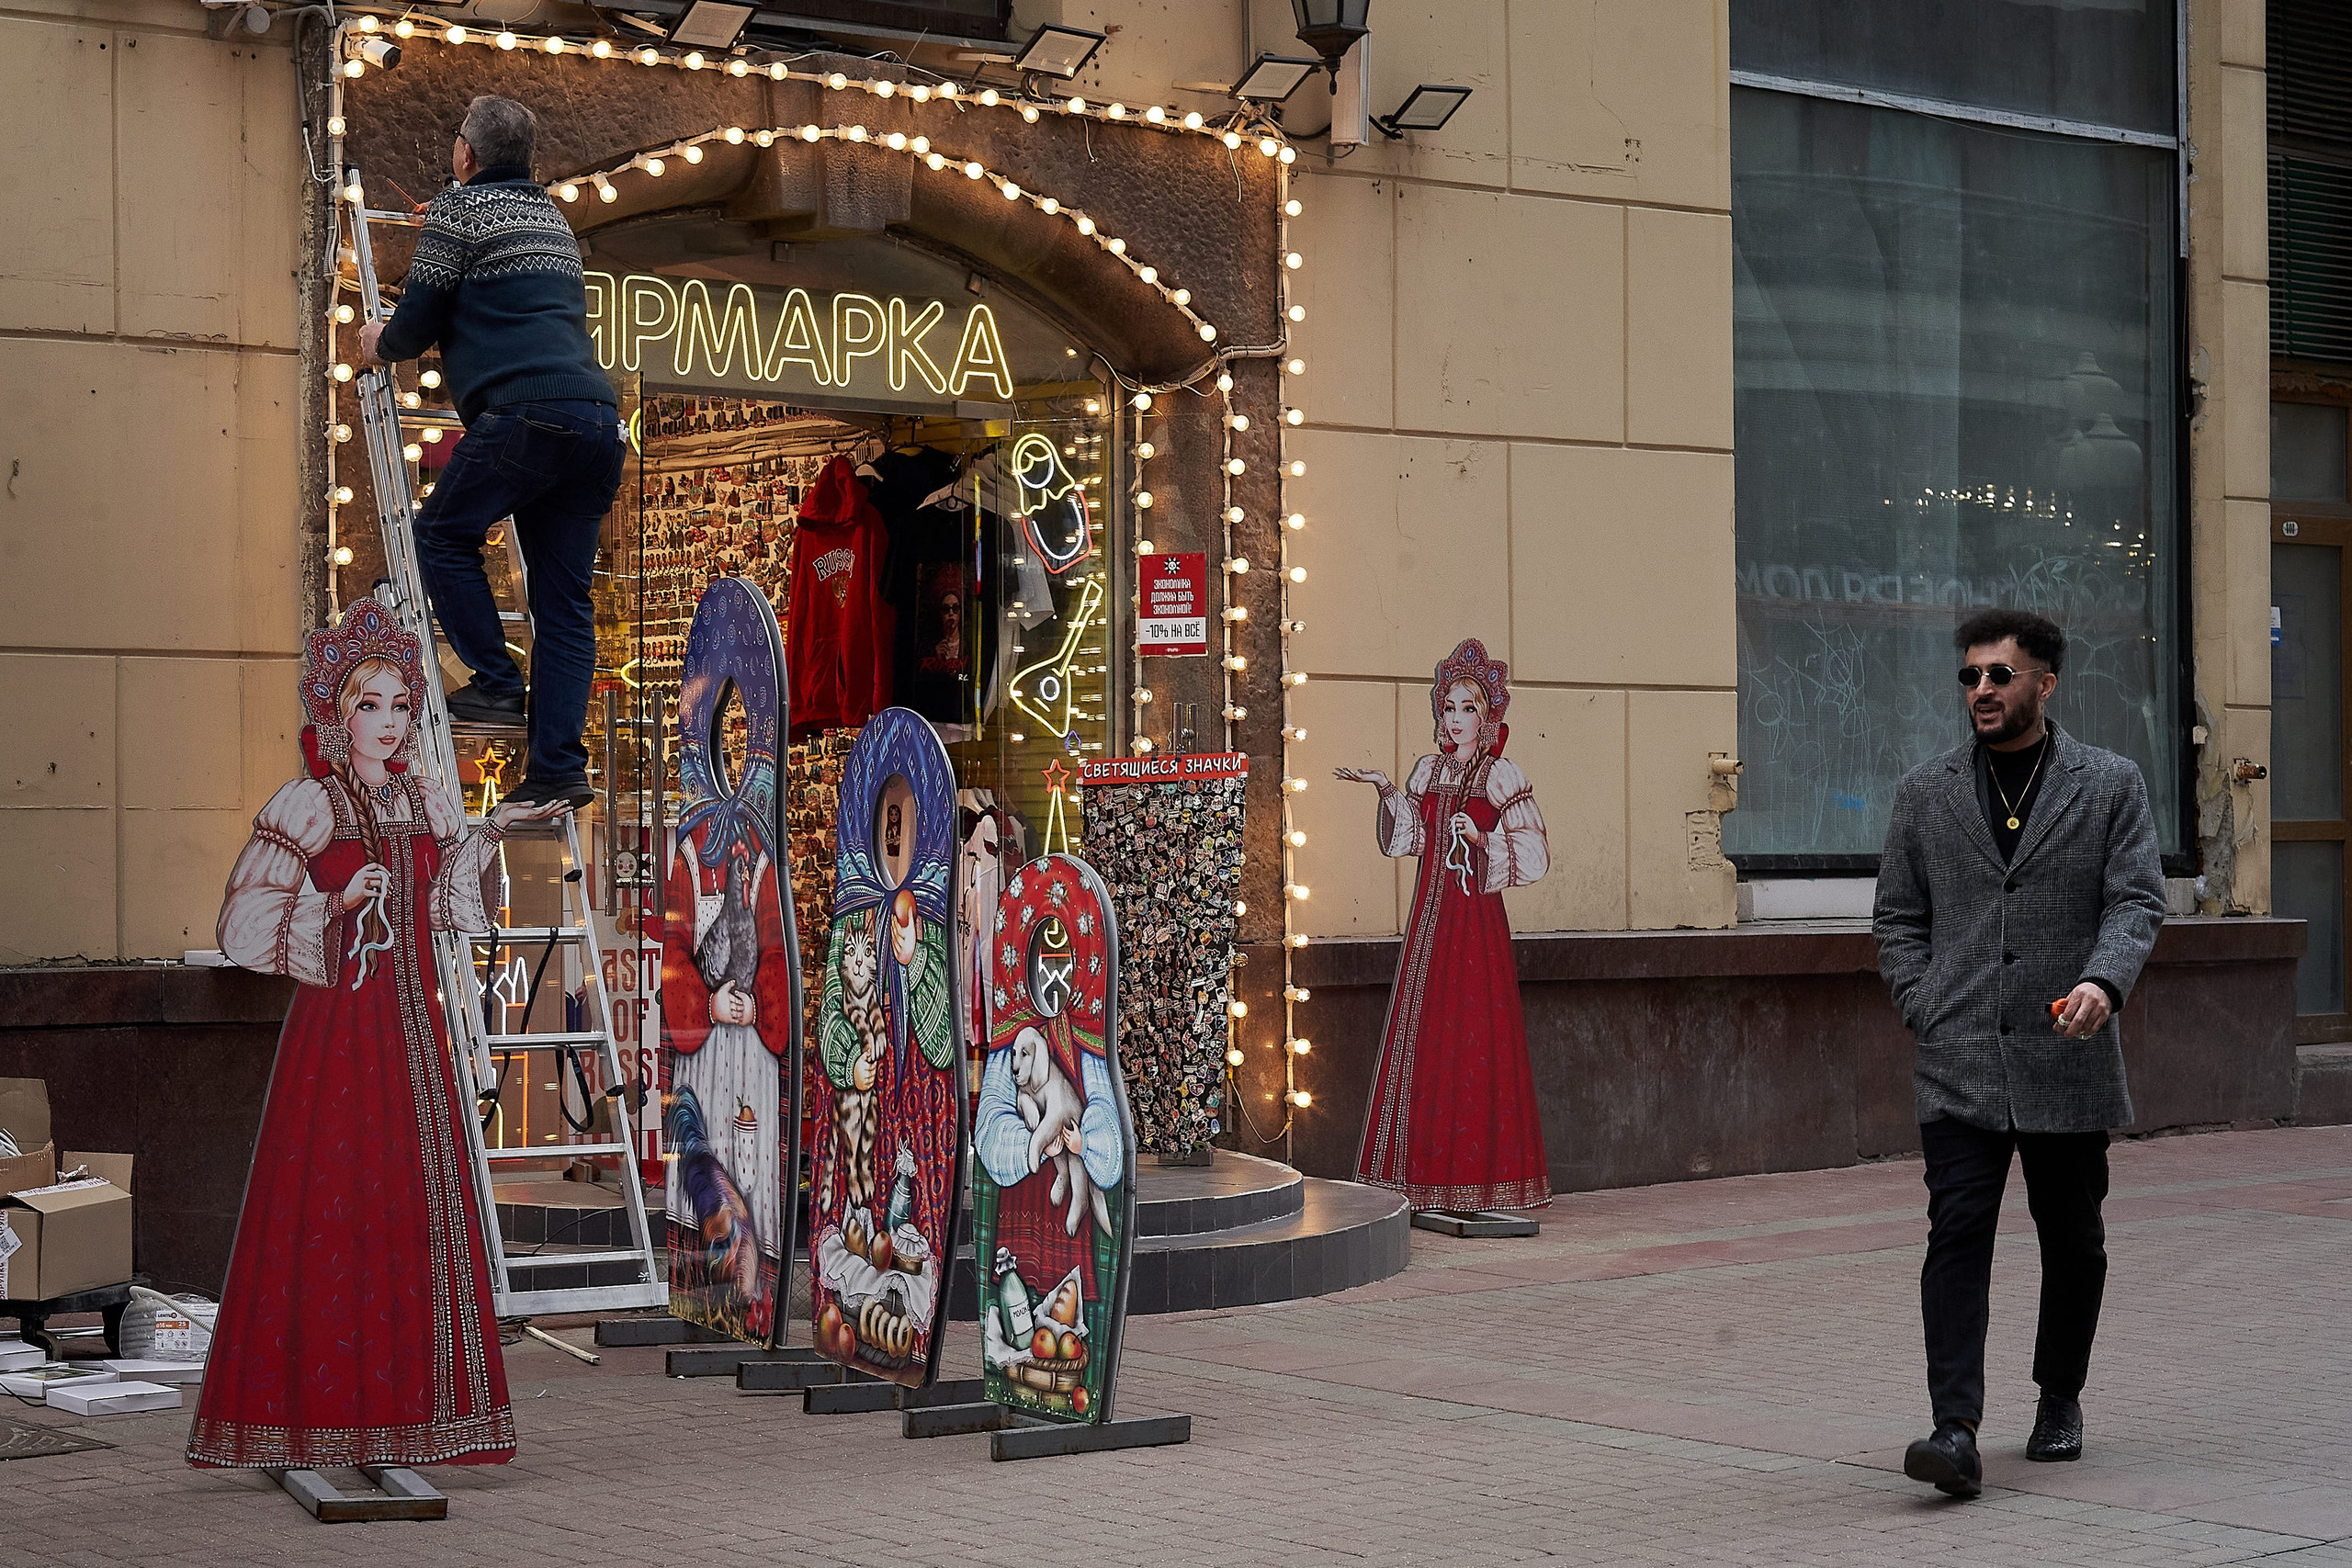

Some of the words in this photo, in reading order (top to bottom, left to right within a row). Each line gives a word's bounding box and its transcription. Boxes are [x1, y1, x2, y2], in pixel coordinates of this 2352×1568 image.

[583, 270, 1014, 399] ЯРМАРКА
[1153, 578, 1192, 590] ЭКОНОМИКА
[1150, 591, 1177, 604] ДОЛЖНА
[1177, 591, 1194, 602] БЫТЬ
[1145, 624, 1169, 638] -10%
[1170, 624, 1182, 638] НА
[1184, 621, 1201, 637] ВСЁ
[1083, 761, 1179, 779] СВЕТЯЩИЕСЯ
[1185, 756, 1241, 774] ЗНАЧКИ
[599, 948, 661, 992] AST
[612, 998, 650, 1043] OF
